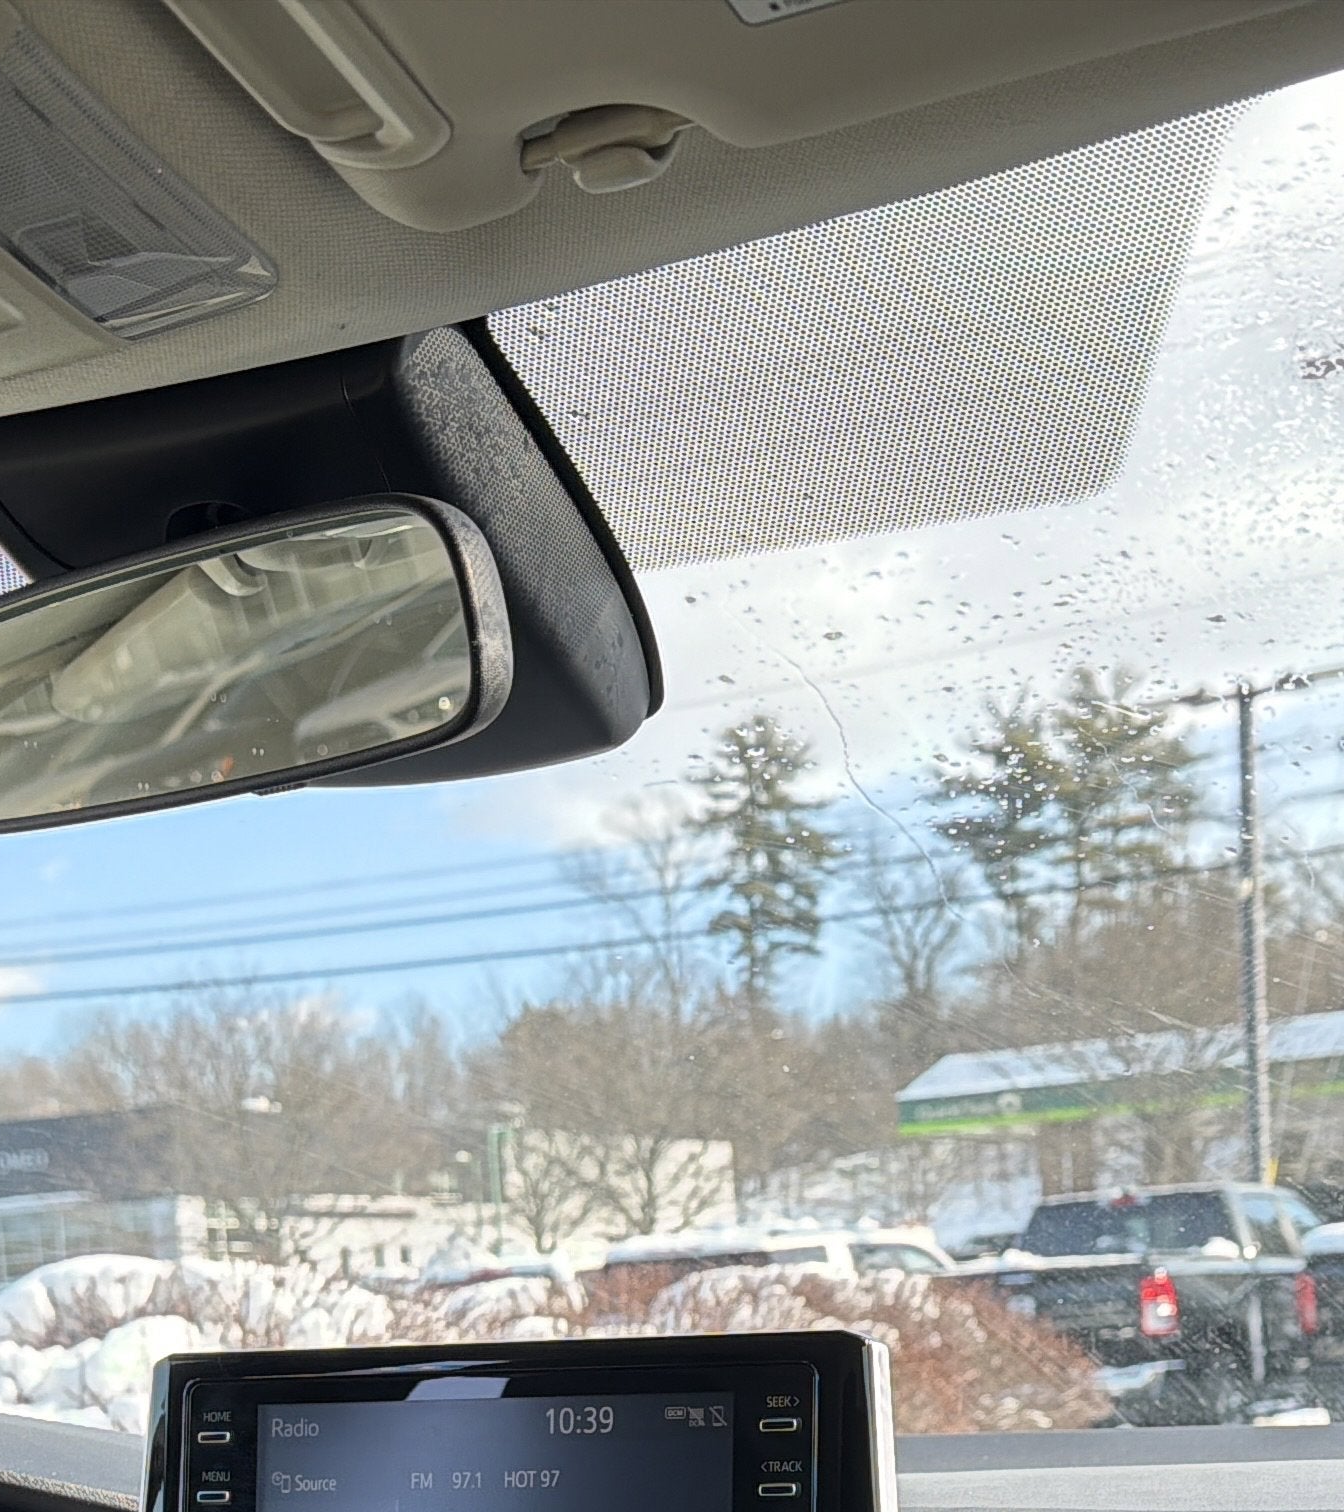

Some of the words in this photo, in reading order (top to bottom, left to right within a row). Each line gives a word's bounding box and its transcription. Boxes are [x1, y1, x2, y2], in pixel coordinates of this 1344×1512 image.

[203, 1411, 233, 1423] HOME
[546, 1406, 614, 1435] 10:39
[271, 1417, 320, 1438] Radio
[201, 1471, 231, 1483] MENU
[295, 1474, 338, 1492] Source
[410, 1472, 433, 1490] FM
[452, 1471, 482, 1490] 97.1
[504, 1470, 537, 1489] HOT
[540, 1470, 560, 1488] 97
